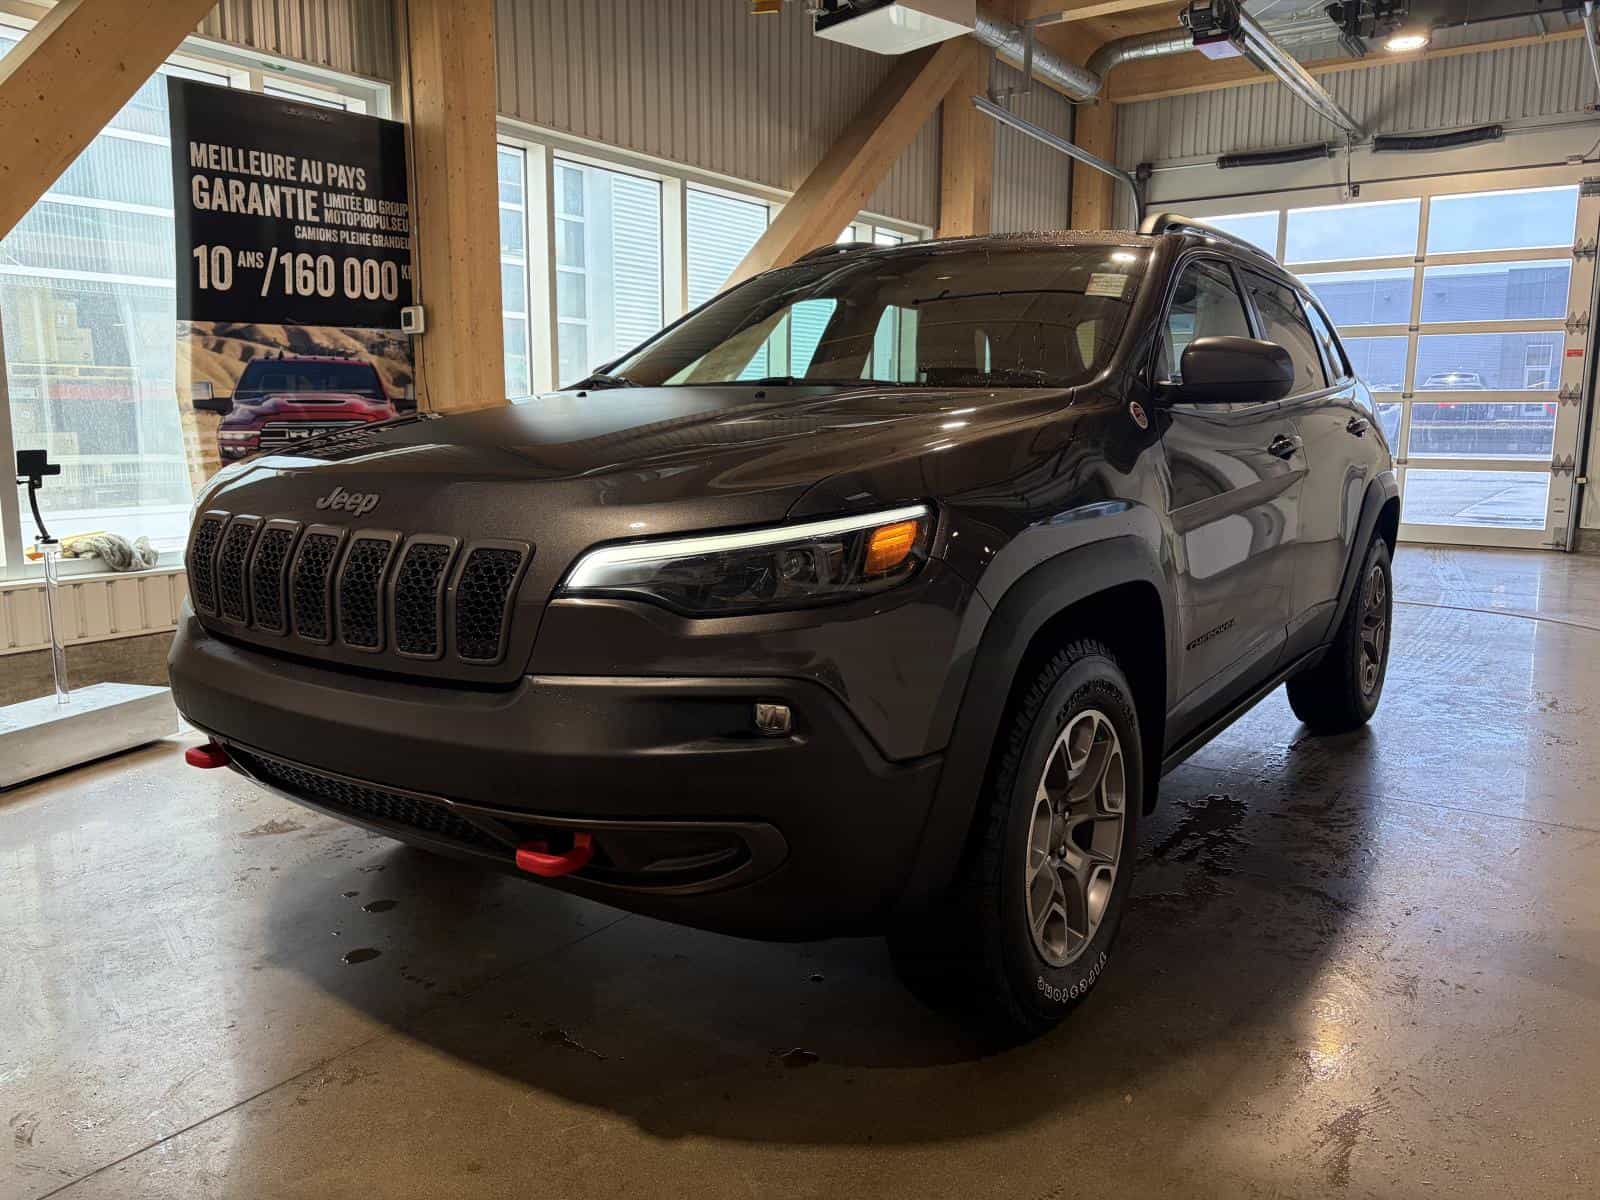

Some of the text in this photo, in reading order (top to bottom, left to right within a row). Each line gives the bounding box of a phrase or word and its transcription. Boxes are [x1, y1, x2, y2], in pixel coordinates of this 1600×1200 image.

[190, 141, 367, 191] MEILLEURE AU PAYS
[192, 174, 320, 222] GARANTIE
[323, 191, 362, 212] LIMITÉE
[364, 198, 378, 214] DU
[294, 225, 338, 243] CAMIONS
[340, 230, 371, 246] PLEINE
[193, 244, 233, 291] 10
[237, 250, 264, 269] ANS
[343, 257, 399, 301] 000
[315, 486, 380, 517] Jeep
